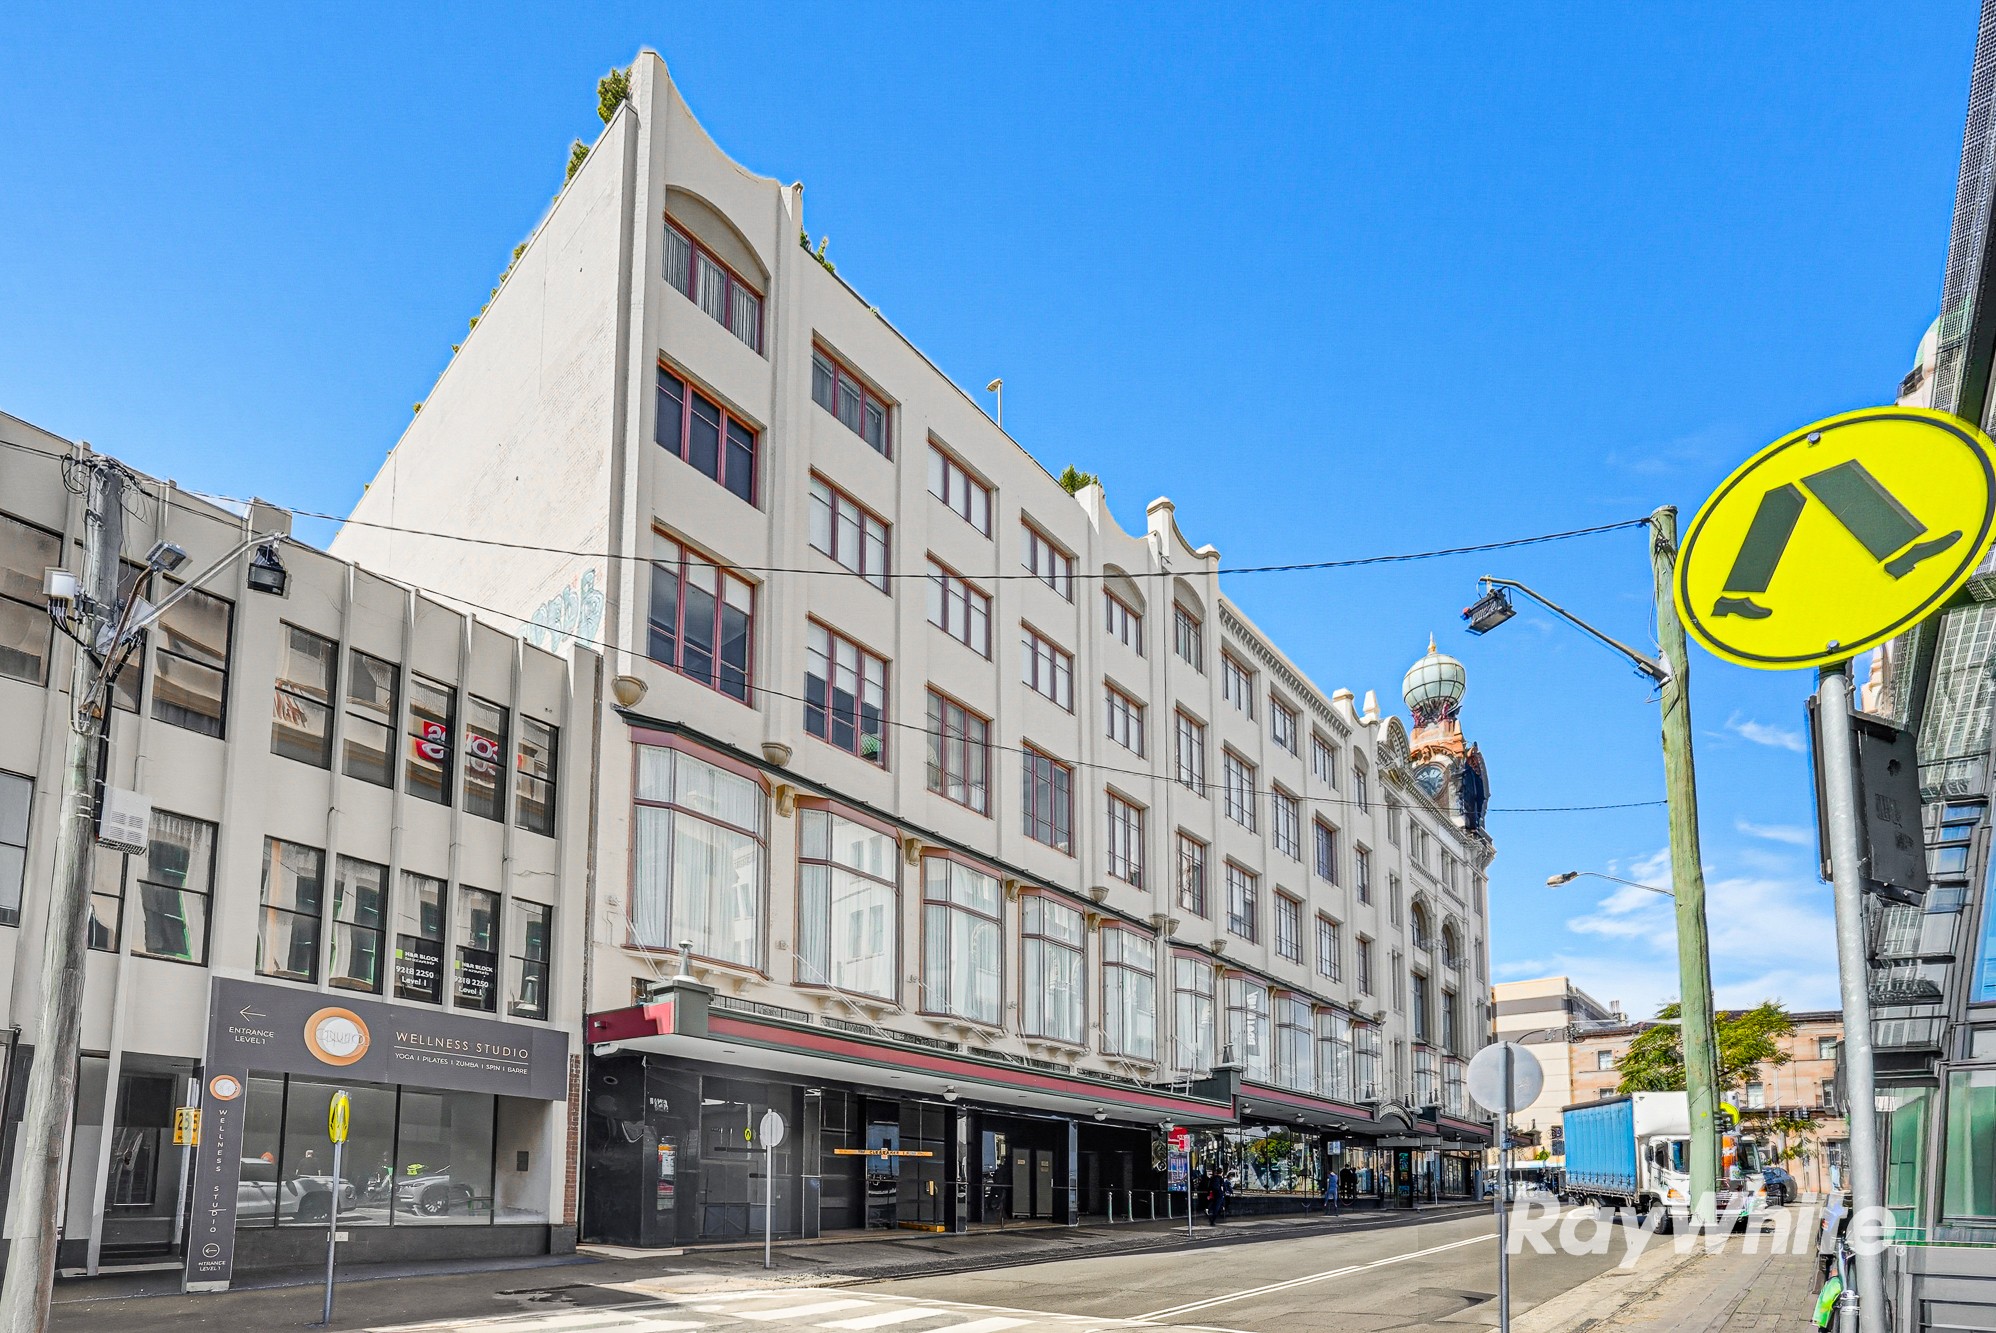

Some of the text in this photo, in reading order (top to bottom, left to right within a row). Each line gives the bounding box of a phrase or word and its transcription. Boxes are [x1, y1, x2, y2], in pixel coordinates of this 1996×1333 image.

[419, 953, 439, 963] BLOCK
[415, 968, 435, 979] 2250
[401, 975, 421, 986] Level
[458, 985, 477, 995] Level
[228, 1026, 275, 1038] ENTRANCE
[234, 1035, 261, 1045] LEVEL
[395, 1031, 529, 1059] WELLNESS STUDIO
[394, 1052, 415, 1061] YOGA
[422, 1056, 449, 1065] PILATES
[455, 1060, 479, 1068] ZUMBA
[507, 1066, 528, 1075] BARRE
[209, 1109, 228, 1233] WELLNESS STUDIO
